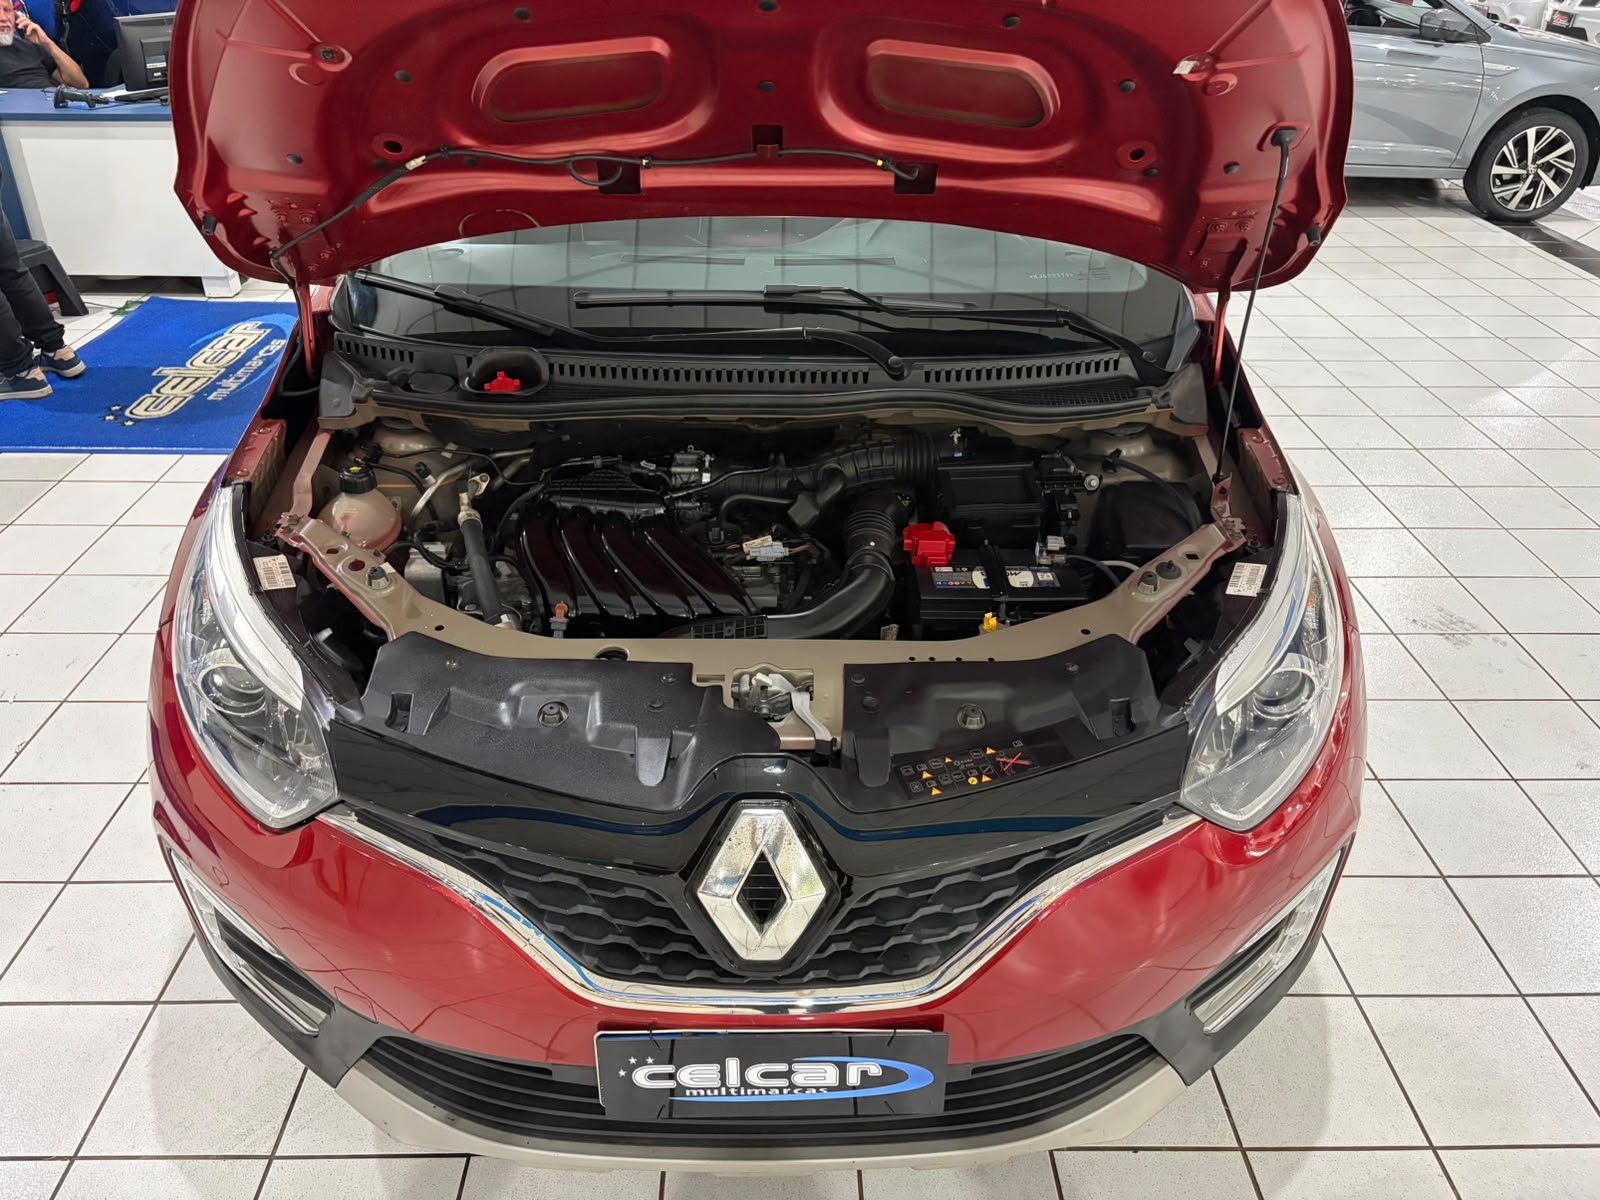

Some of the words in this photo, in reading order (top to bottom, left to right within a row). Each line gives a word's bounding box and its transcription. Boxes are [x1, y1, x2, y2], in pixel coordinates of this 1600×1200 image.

[124, 321, 272, 419] celcar
[207, 339, 287, 401] multimarcas
[632, 1057, 883, 1089] celcar
[685, 1086, 828, 1097] multimarcas
